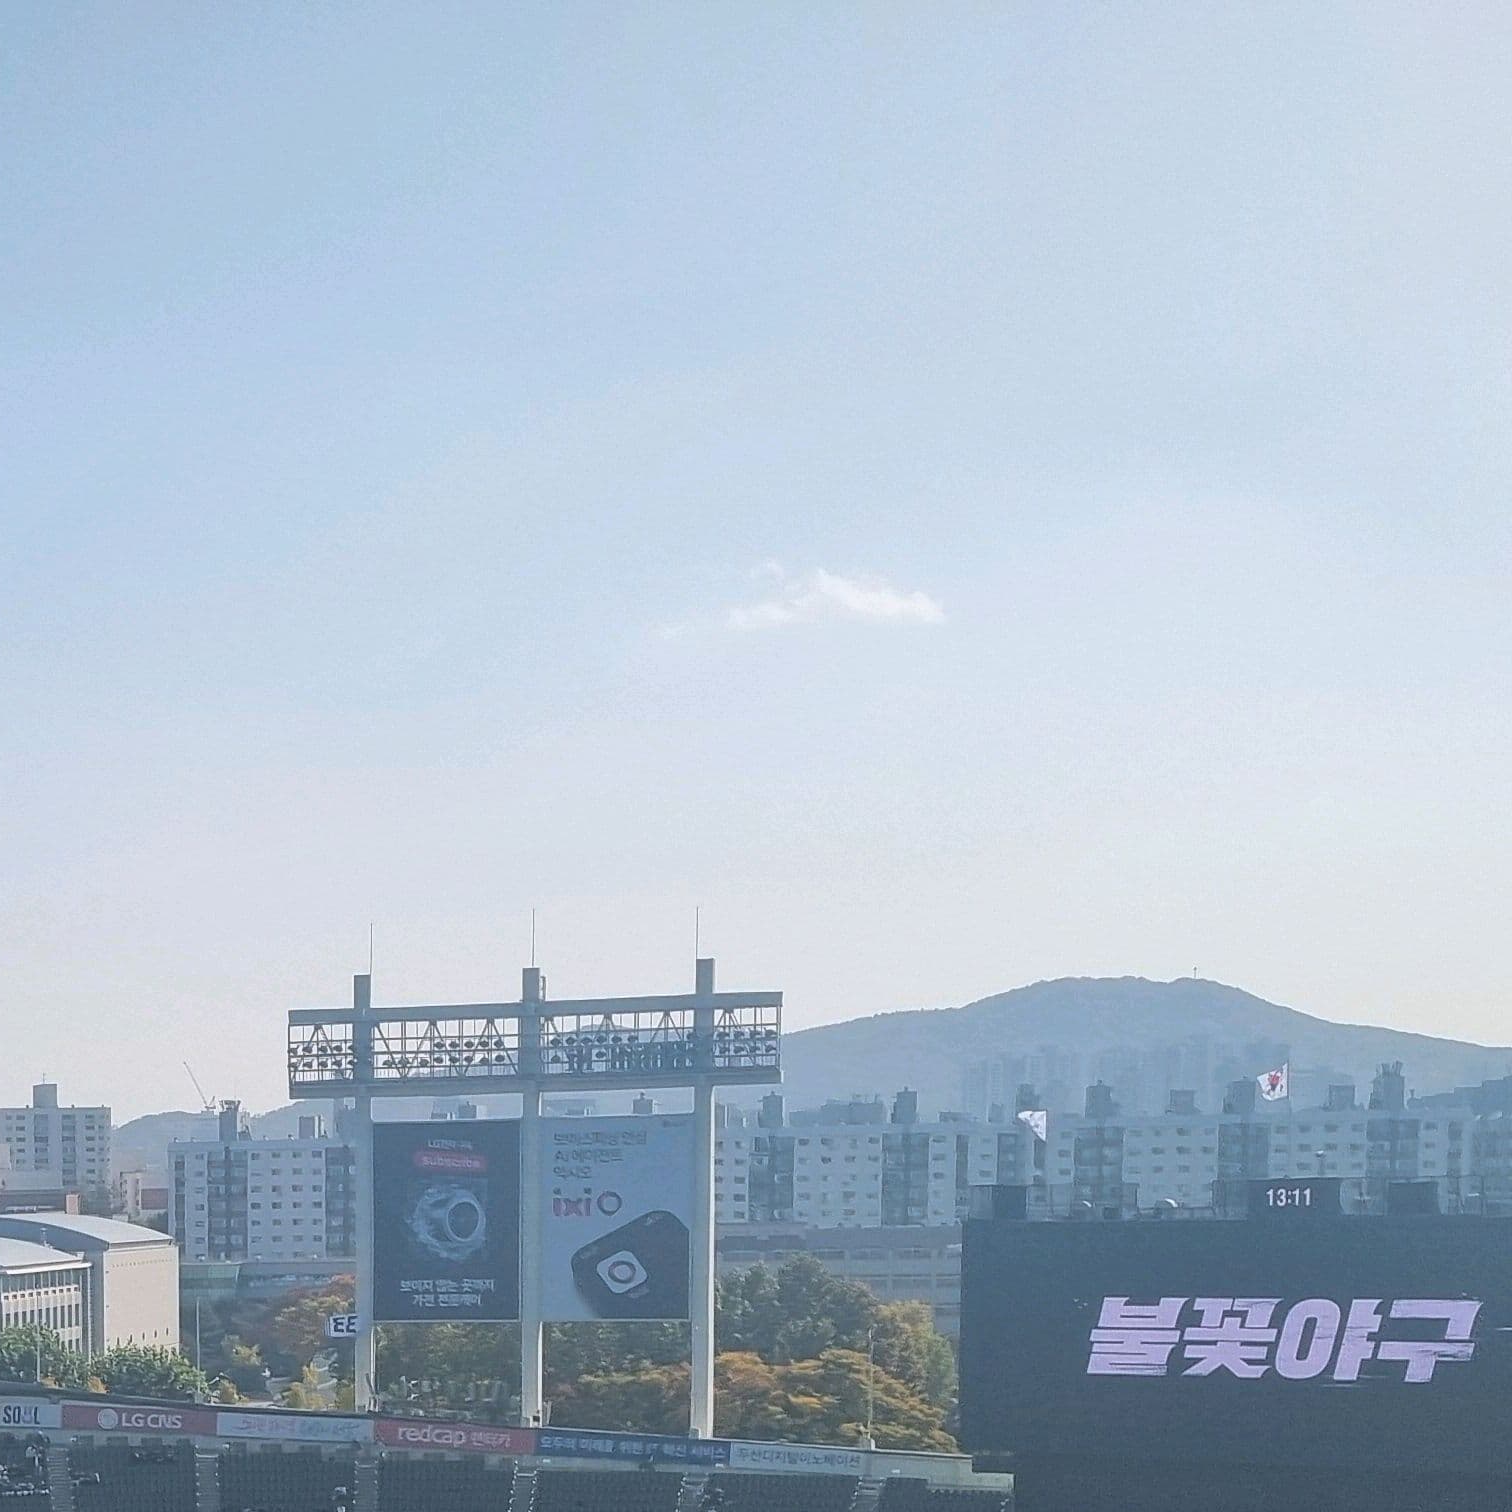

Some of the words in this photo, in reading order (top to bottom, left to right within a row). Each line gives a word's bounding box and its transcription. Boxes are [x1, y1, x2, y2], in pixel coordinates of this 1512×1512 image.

[1265, 1188, 1312, 1207] 13:11
[1087, 1296, 1484, 1383] 불꽃야구
[121, 1411, 145, 1428] LG
[147, 1413, 182, 1430] CNS
[398, 1424, 466, 1445] redcap
